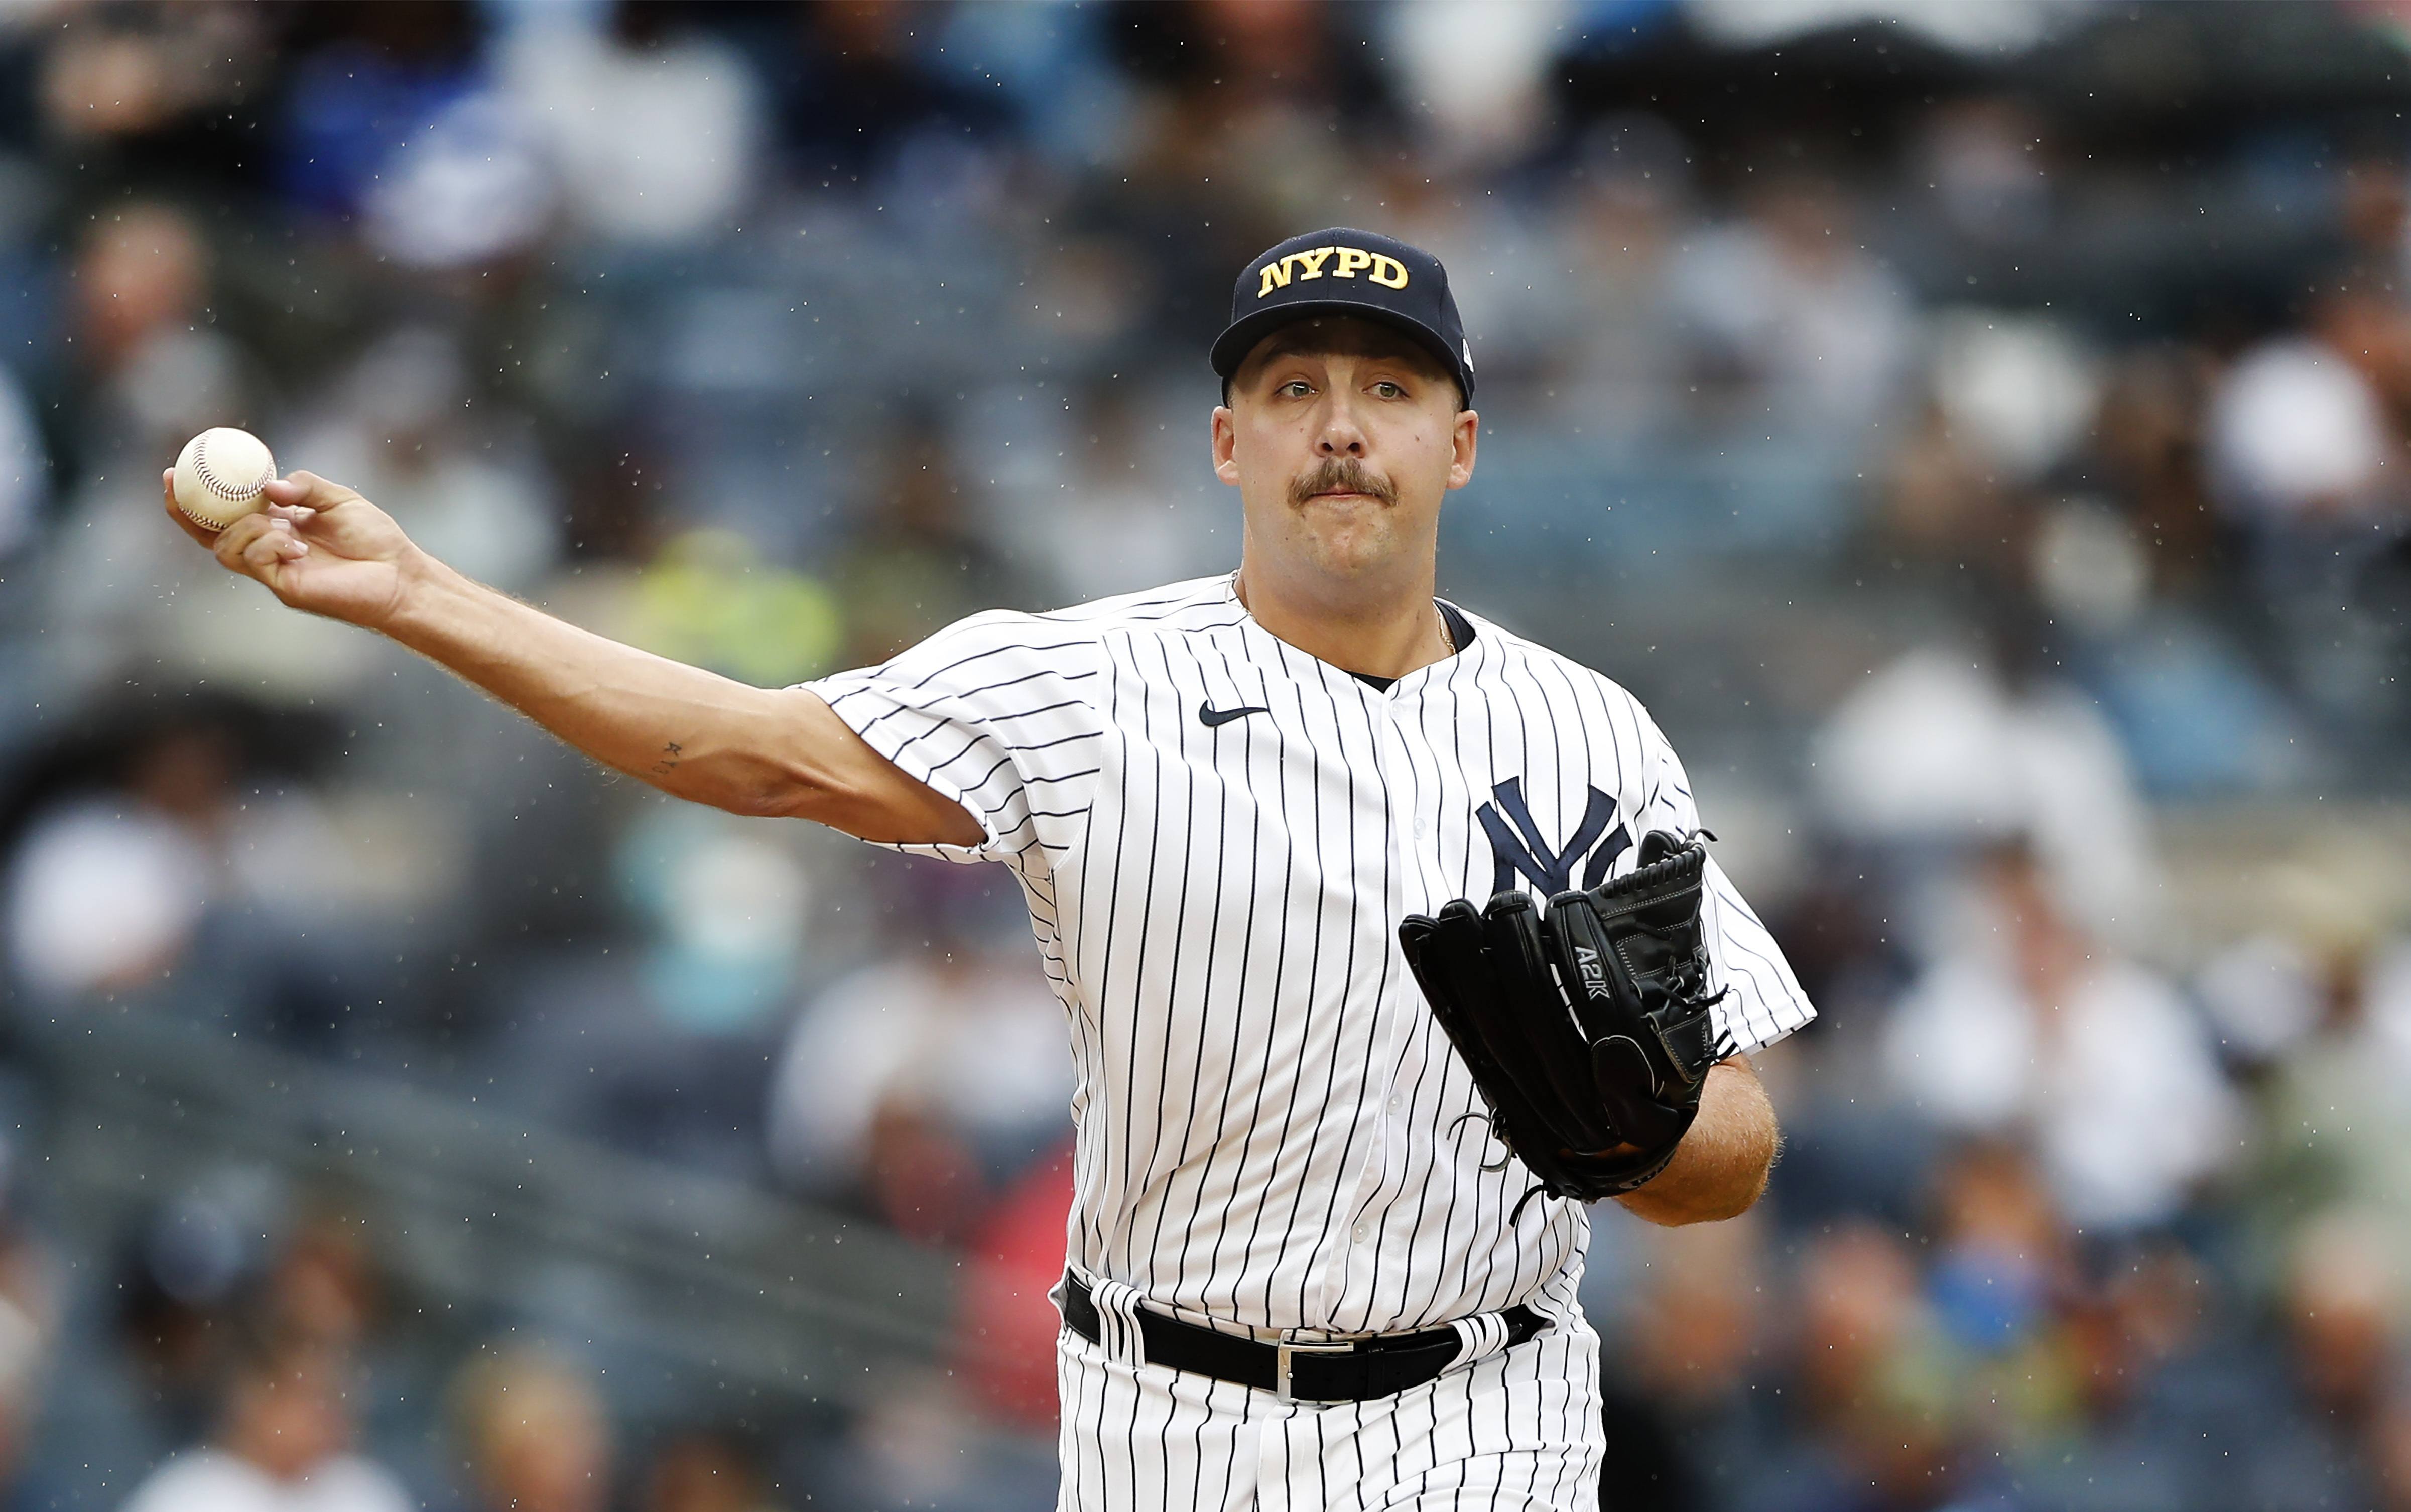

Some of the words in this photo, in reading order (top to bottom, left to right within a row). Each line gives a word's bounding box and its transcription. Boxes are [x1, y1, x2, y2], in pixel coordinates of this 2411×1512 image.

[1257, 246, 1409, 298] NYPD
[1475, 776, 1633, 904] NY
[1574, 946, 1610, 1000] A2K
